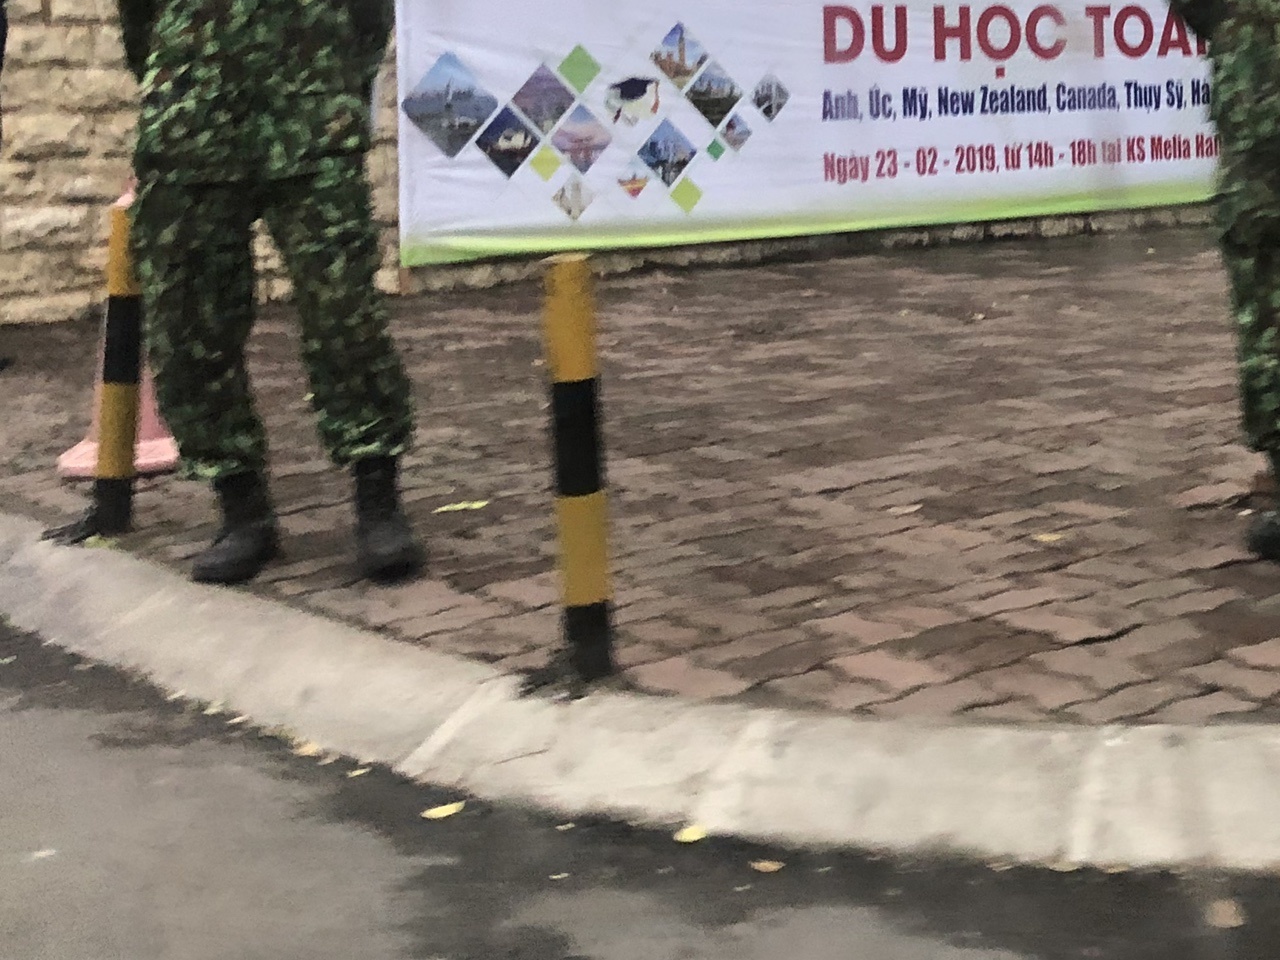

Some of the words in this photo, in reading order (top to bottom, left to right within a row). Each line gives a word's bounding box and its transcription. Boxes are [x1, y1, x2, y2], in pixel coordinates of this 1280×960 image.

[823, 4, 908, 64] DU
[933, 4, 1066, 78] HỌC
[1085, 3, 1207, 57] TOA
[822, 89, 863, 122] Anh,
[869, 83, 896, 121] Úc,
[902, 87, 932, 121] Mỹ,
[937, 87, 975, 116] New
[980, 82, 1051, 114] Zealand,
[1056, 81, 1119, 112] Canada,
[875, 147, 898, 179] 23
[916, 145, 938, 176] 02
[955, 143, 1000, 174] 2019,
[1026, 141, 1054, 169] 14h
[1069, 138, 1096, 166] 18h
[1127, 135, 1146, 164] KS
[1150, 134, 1191, 162] Melia
